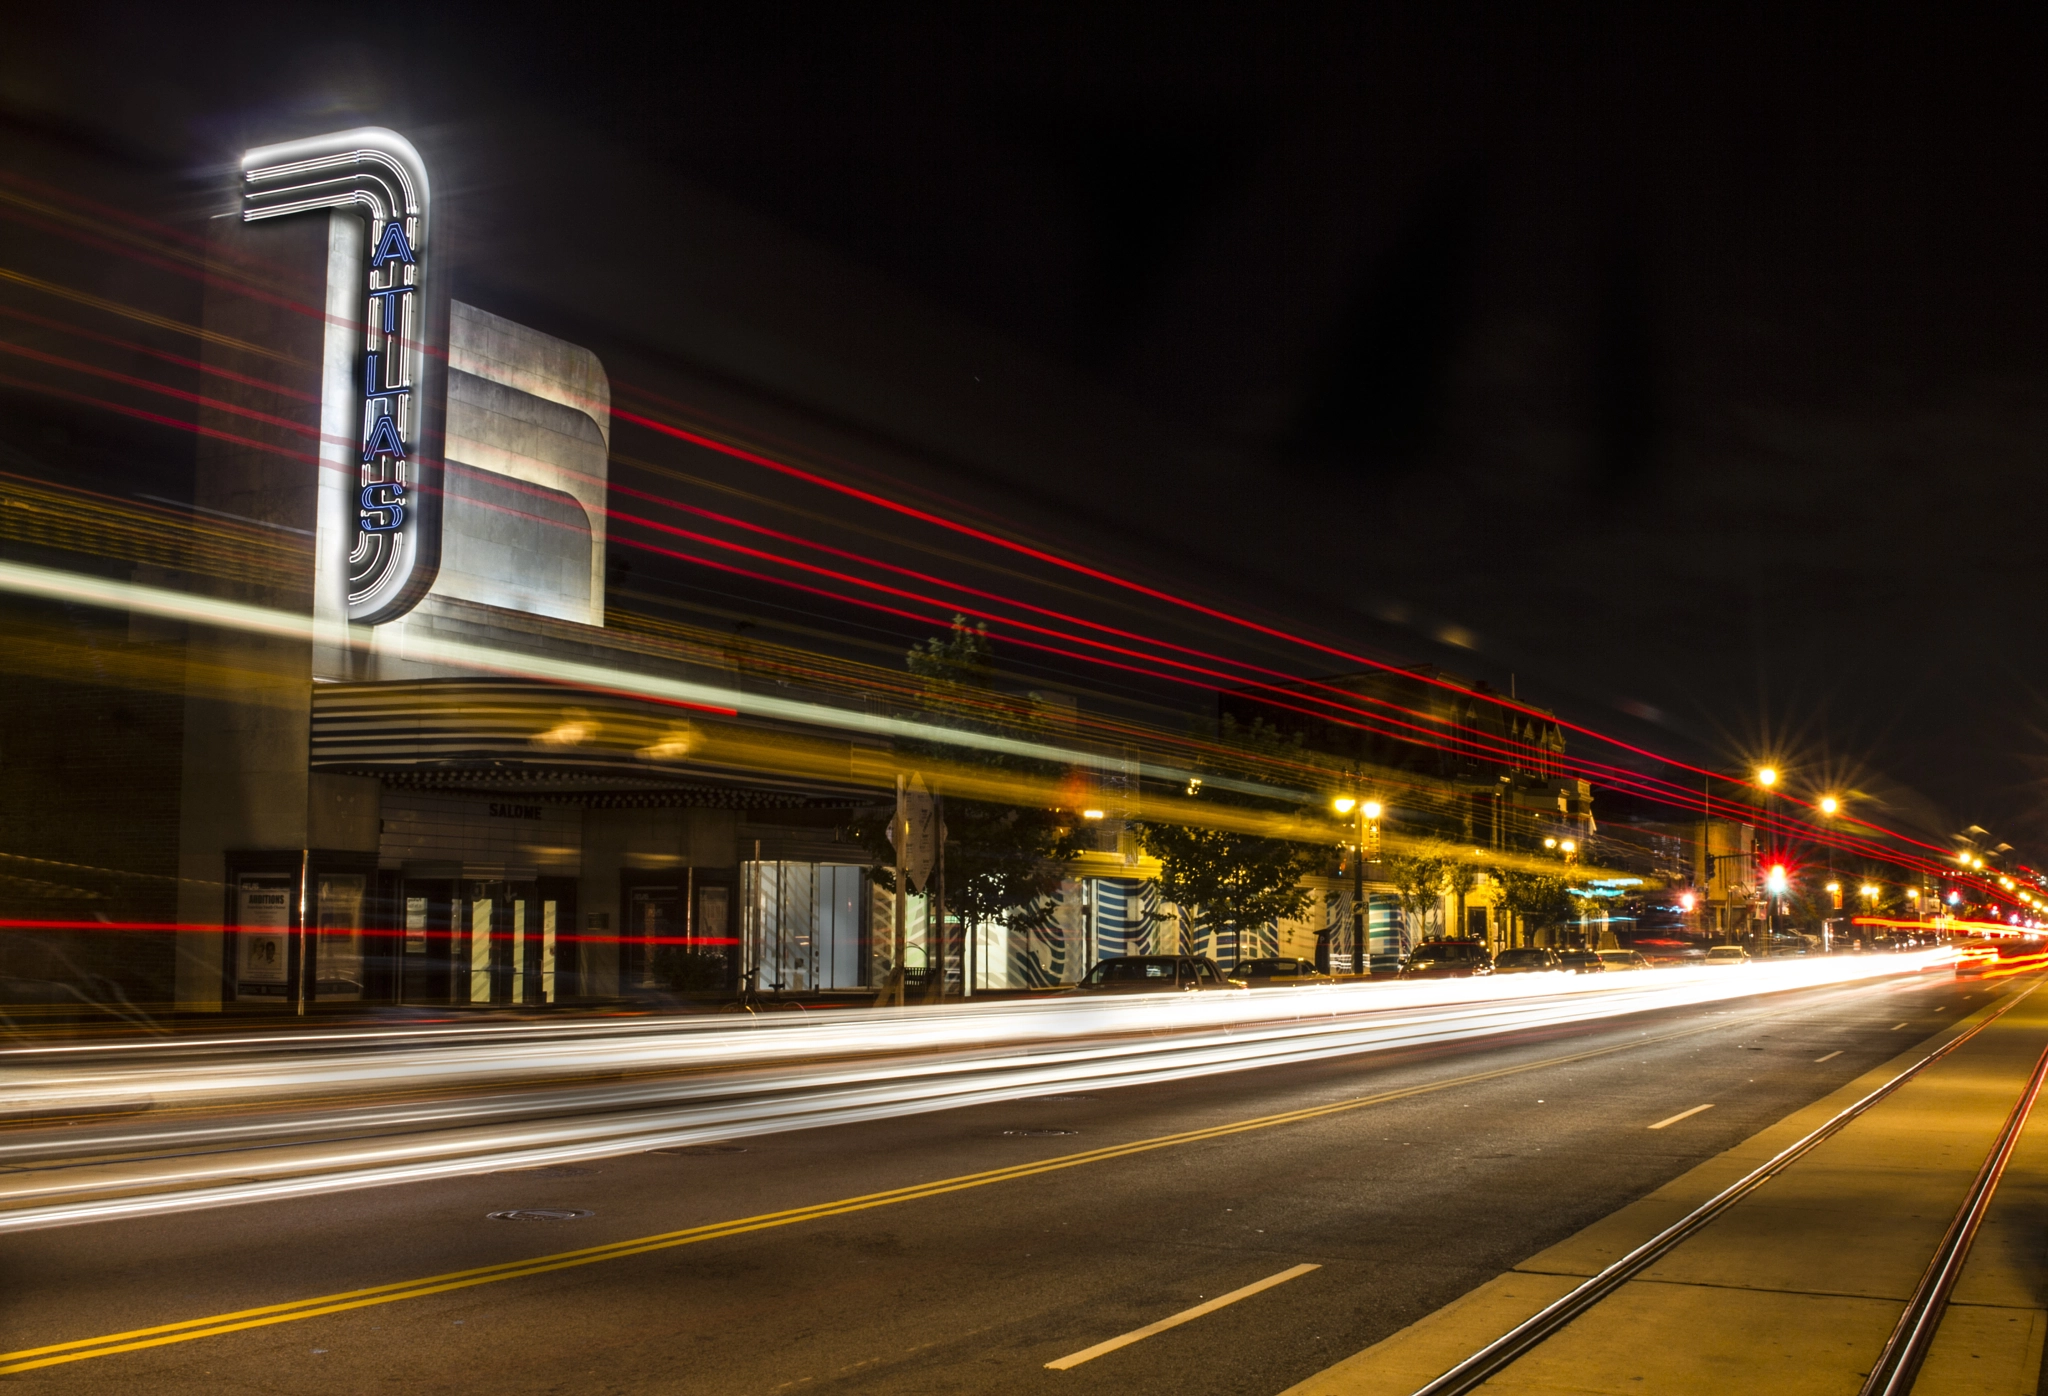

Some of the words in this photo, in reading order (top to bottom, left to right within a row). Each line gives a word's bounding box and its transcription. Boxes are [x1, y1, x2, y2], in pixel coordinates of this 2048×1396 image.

[361, 222, 415, 531] ATLAS
[489, 803, 542, 820] SALOME
[248, 894, 285, 905] AUDITIONS
